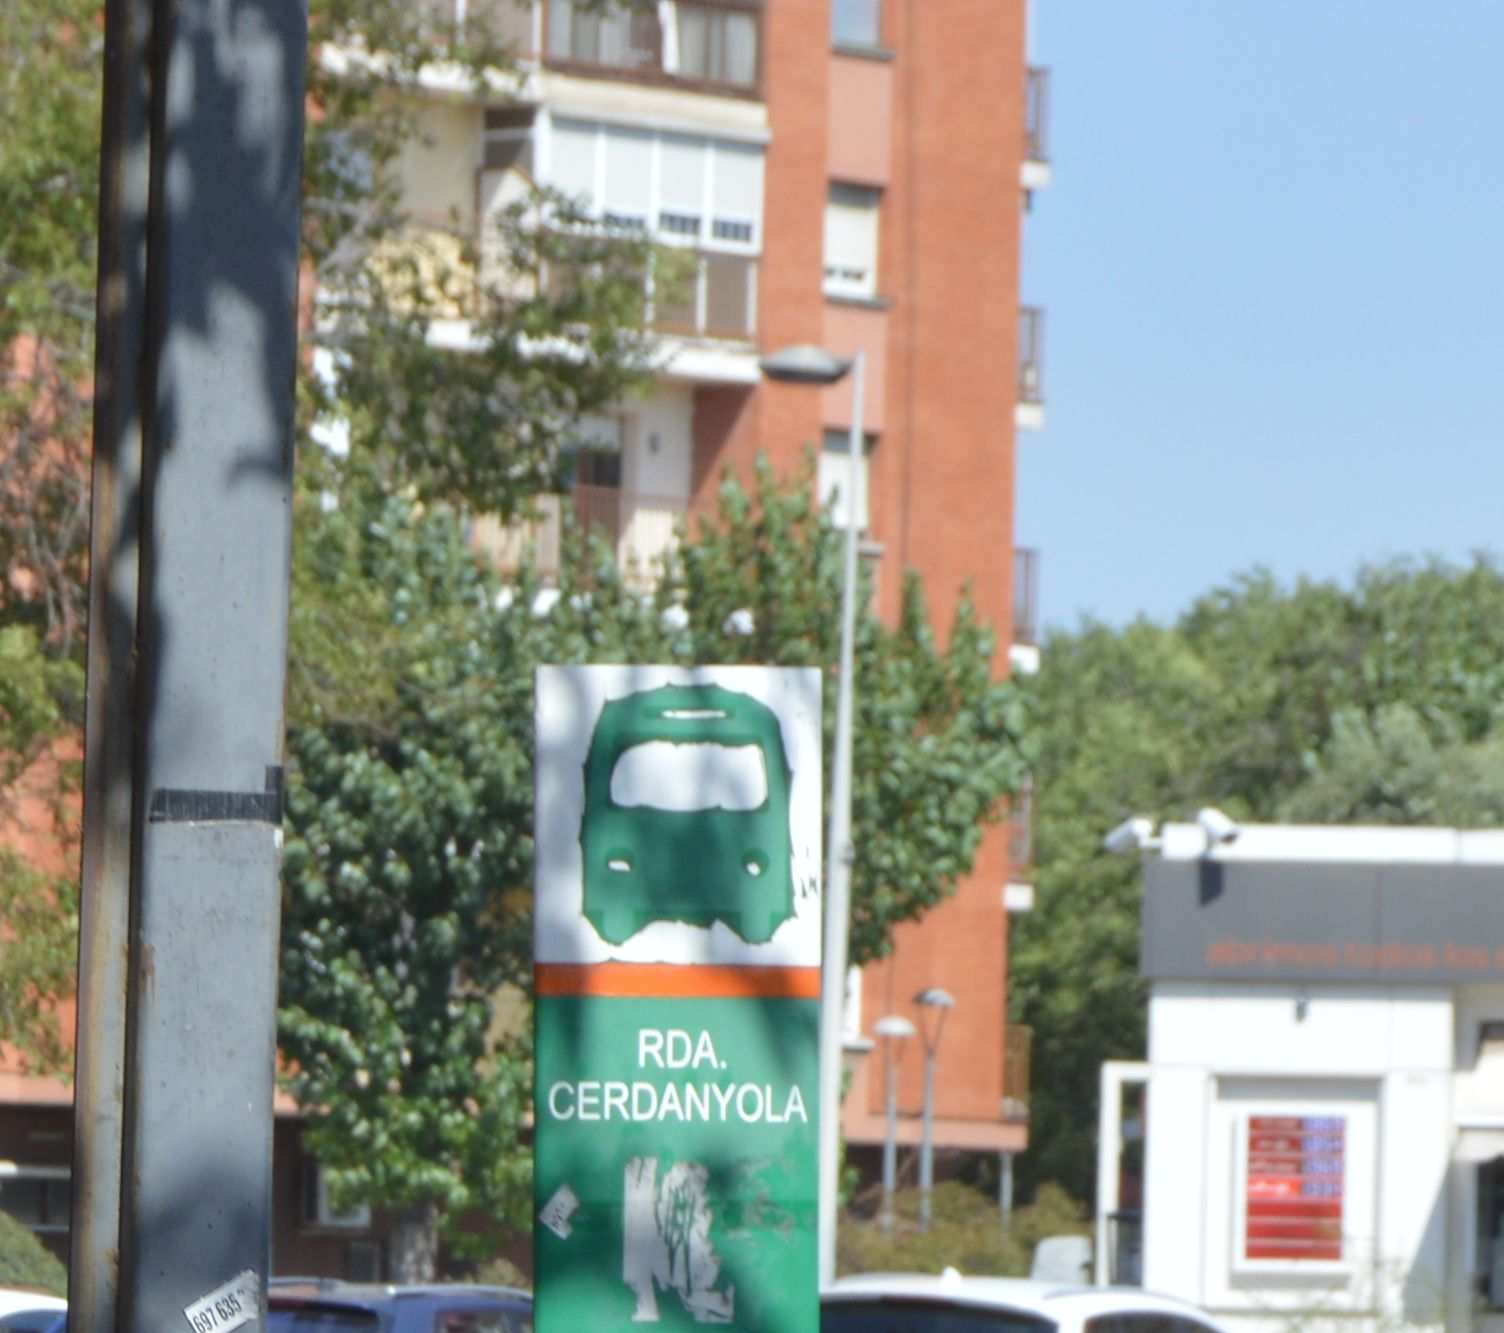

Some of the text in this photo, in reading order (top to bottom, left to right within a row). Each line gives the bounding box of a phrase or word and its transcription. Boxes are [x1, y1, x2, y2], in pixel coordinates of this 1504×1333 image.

[1205, 937, 1339, 968] abrimos
[1344, 939, 1437, 969] todos
[1443, 940, 1490, 970] los
[638, 1028, 727, 1069] RDA.
[548, 1081, 808, 1123] CERDANYOLA
[214, 1294, 242, 1321] 635
